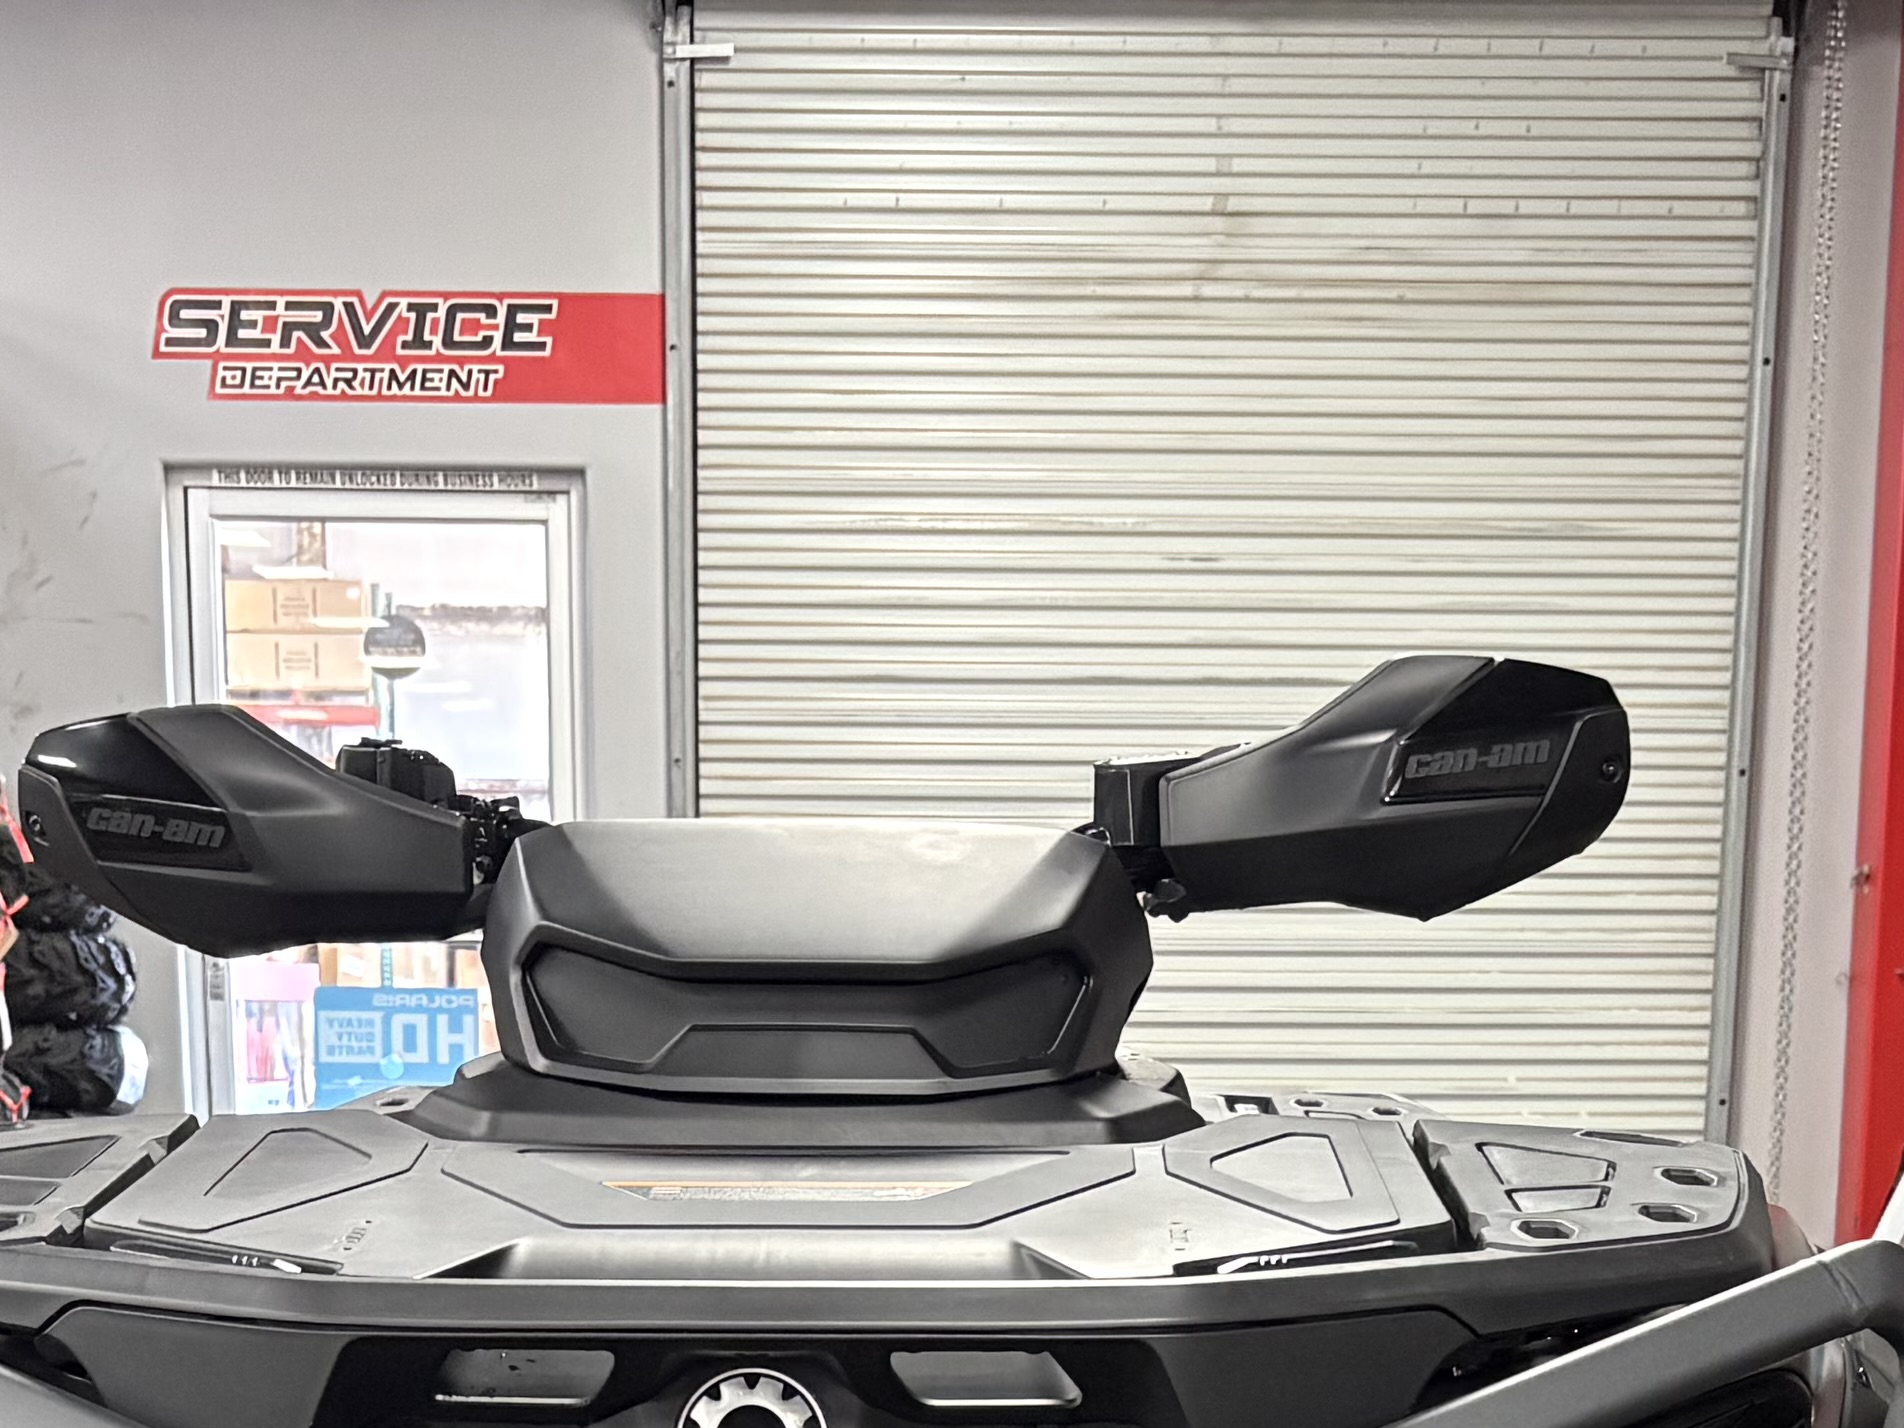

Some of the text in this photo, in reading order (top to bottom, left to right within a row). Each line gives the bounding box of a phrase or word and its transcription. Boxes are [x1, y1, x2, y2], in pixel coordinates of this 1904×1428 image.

[160, 297, 556, 355] SERVICE
[216, 362, 503, 396] DEPARTMENT
[1404, 738, 1552, 781] can-am
[86, 807, 226, 848] can-am
